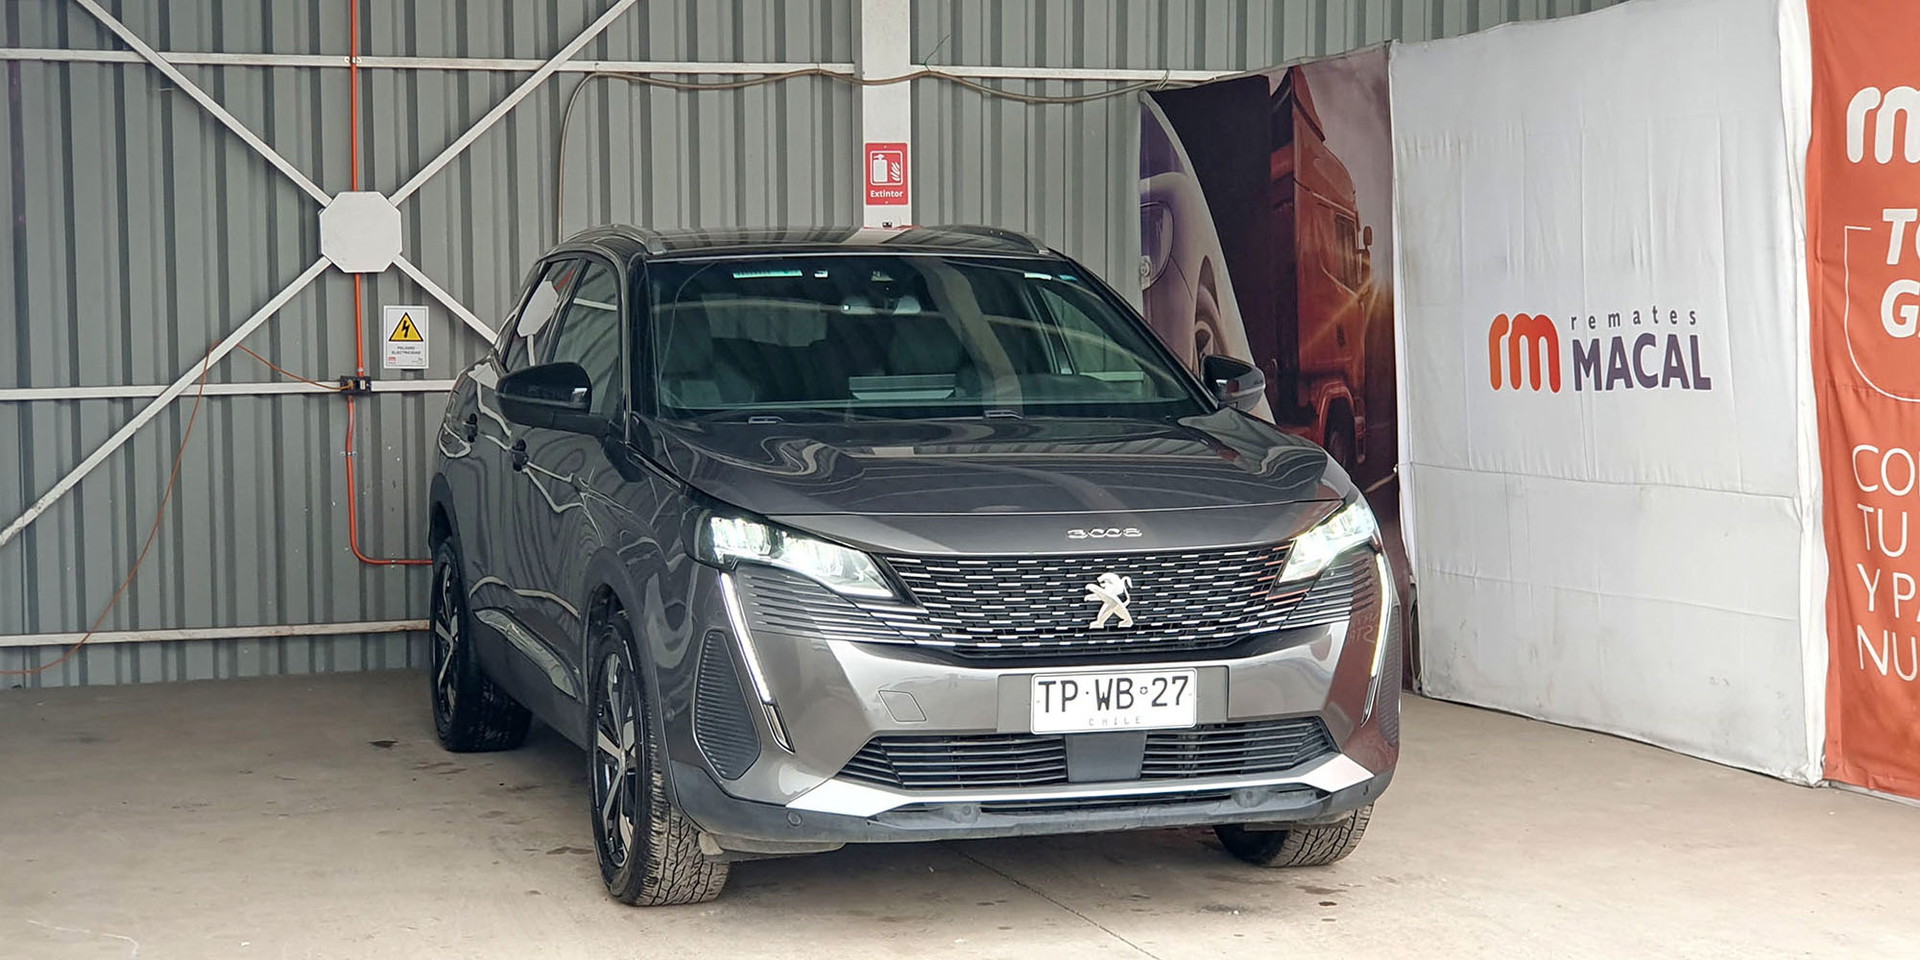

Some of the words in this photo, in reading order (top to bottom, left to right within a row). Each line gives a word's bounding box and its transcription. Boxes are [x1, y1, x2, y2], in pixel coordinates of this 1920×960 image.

[870, 189, 903, 197] Extintor
[1882, 208, 1920, 265] T
[1571, 305, 1697, 330] remates
[1880, 279, 1920, 338] G
[1572, 332, 1712, 391] MACAL
[1852, 444, 1920, 496] CO
[1857, 503, 1907, 557] TU
[1857, 563, 1881, 612] Y
[1893, 572, 1920, 622] P
[1857, 625, 1918, 681] NU
[1088, 716, 1141, 726] CHILE
